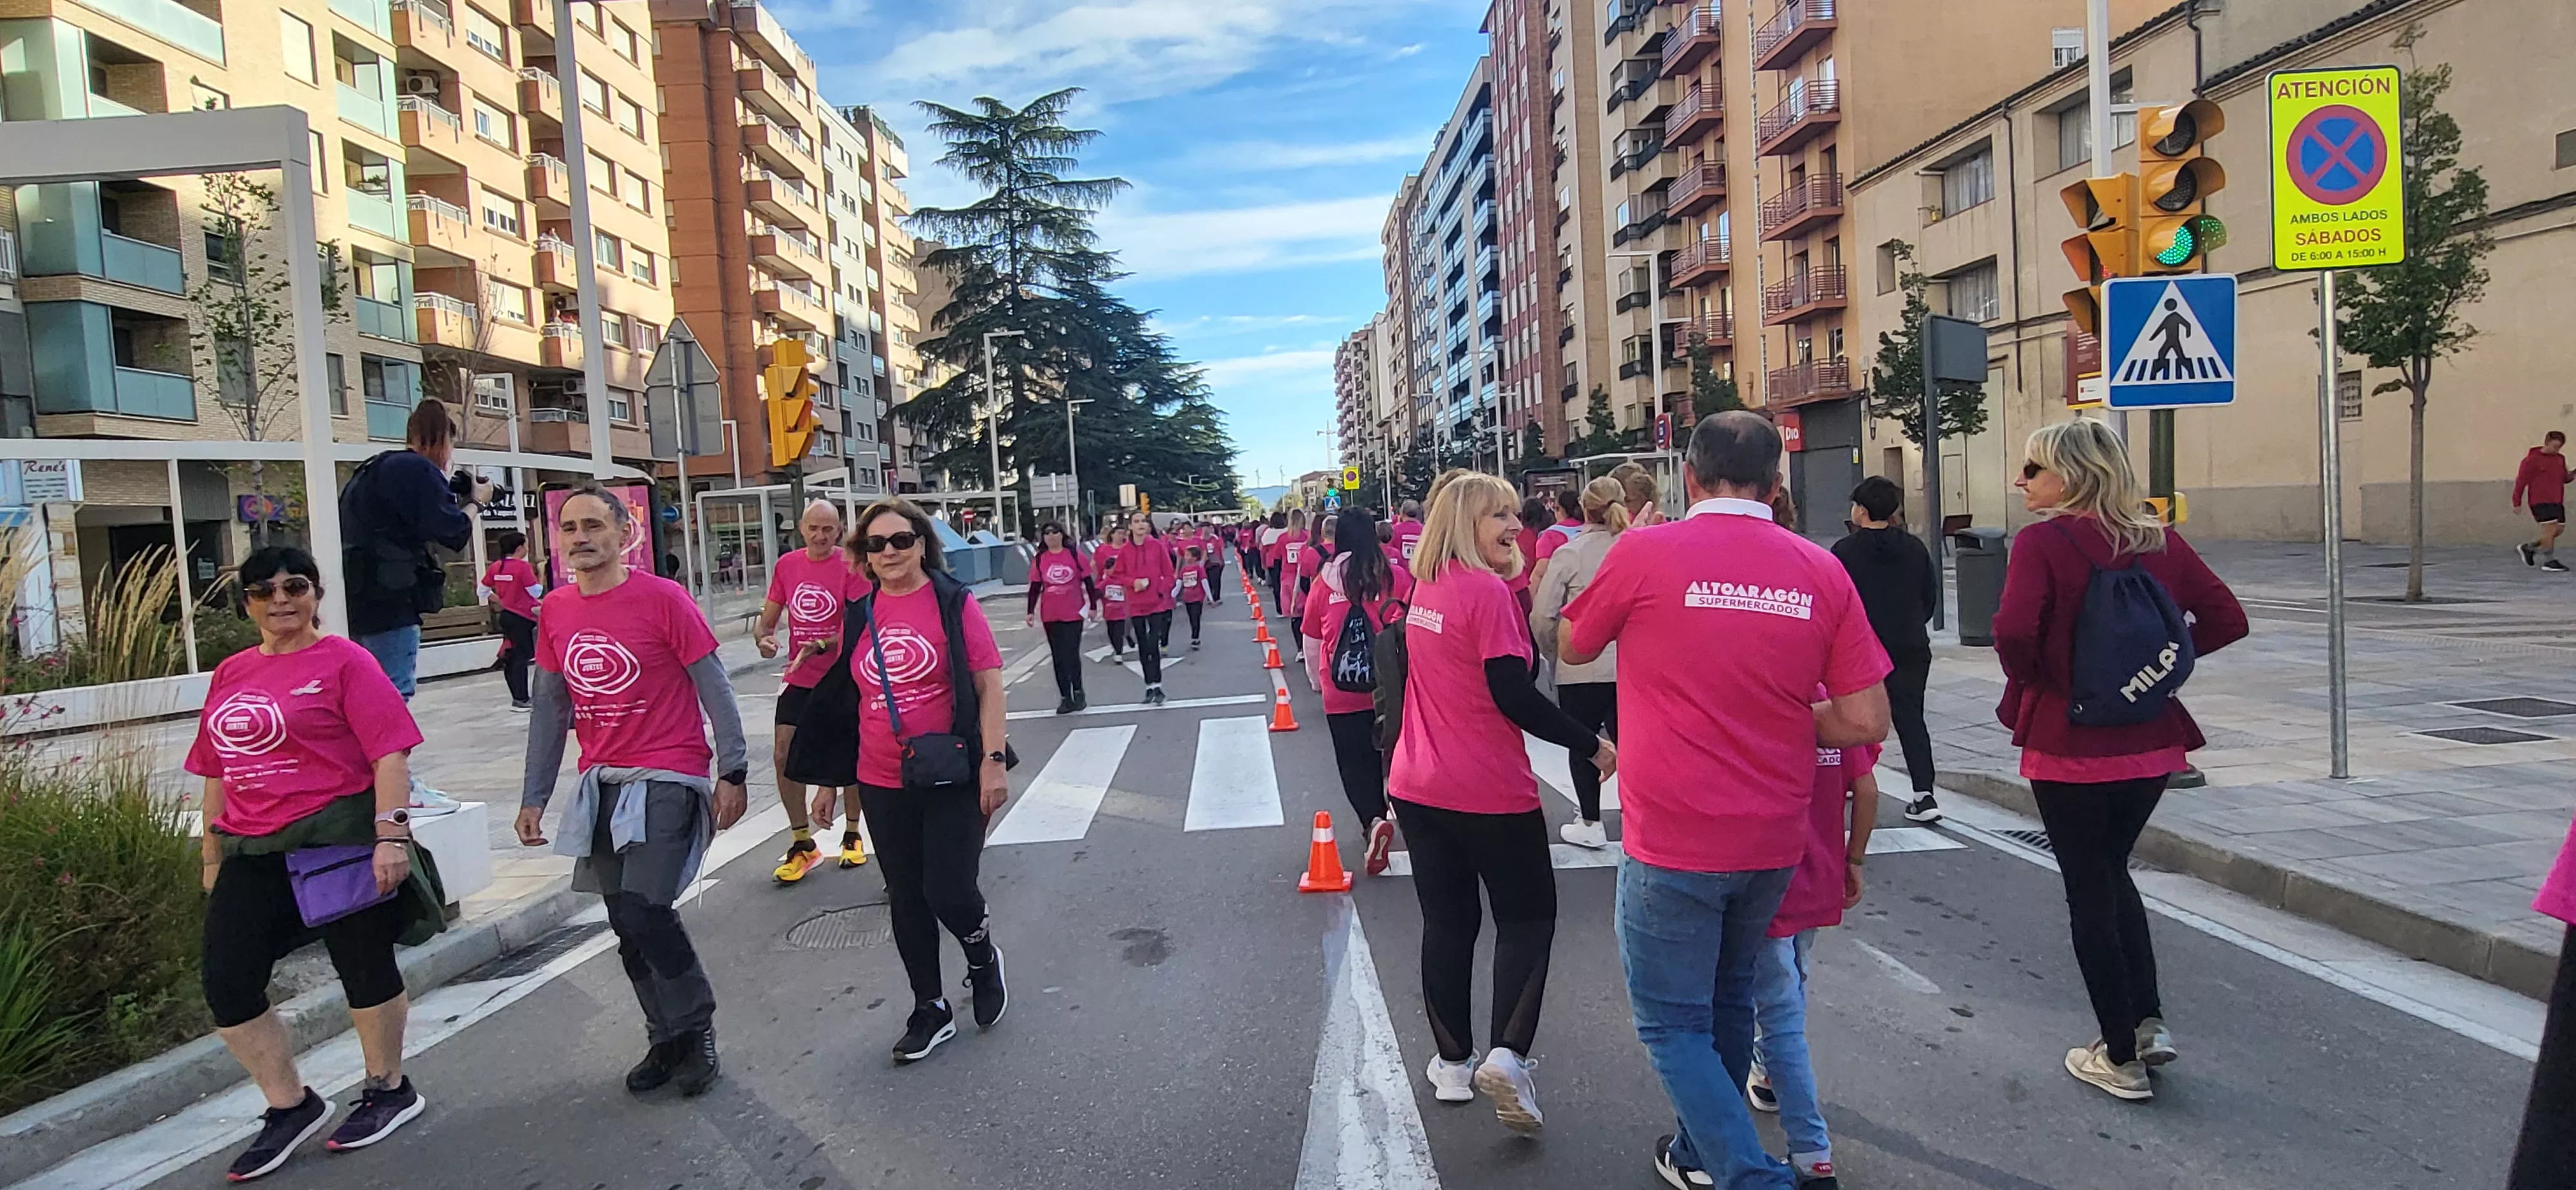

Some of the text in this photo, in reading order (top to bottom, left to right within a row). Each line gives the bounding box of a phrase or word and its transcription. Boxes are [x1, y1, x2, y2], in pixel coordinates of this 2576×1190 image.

[2277, 73, 2391, 99] ATENCIÓN
[2290, 209, 2388, 224] AMBOS LADOS
[2295, 228, 2382, 246] SÁBADOS
[2291, 247, 2386, 262] DE 6:00 A 15:00 H
[1685, 580, 1814, 607] ALTOARAGÓN
[1698, 596, 1800, 616] SUPERMERCADOS
